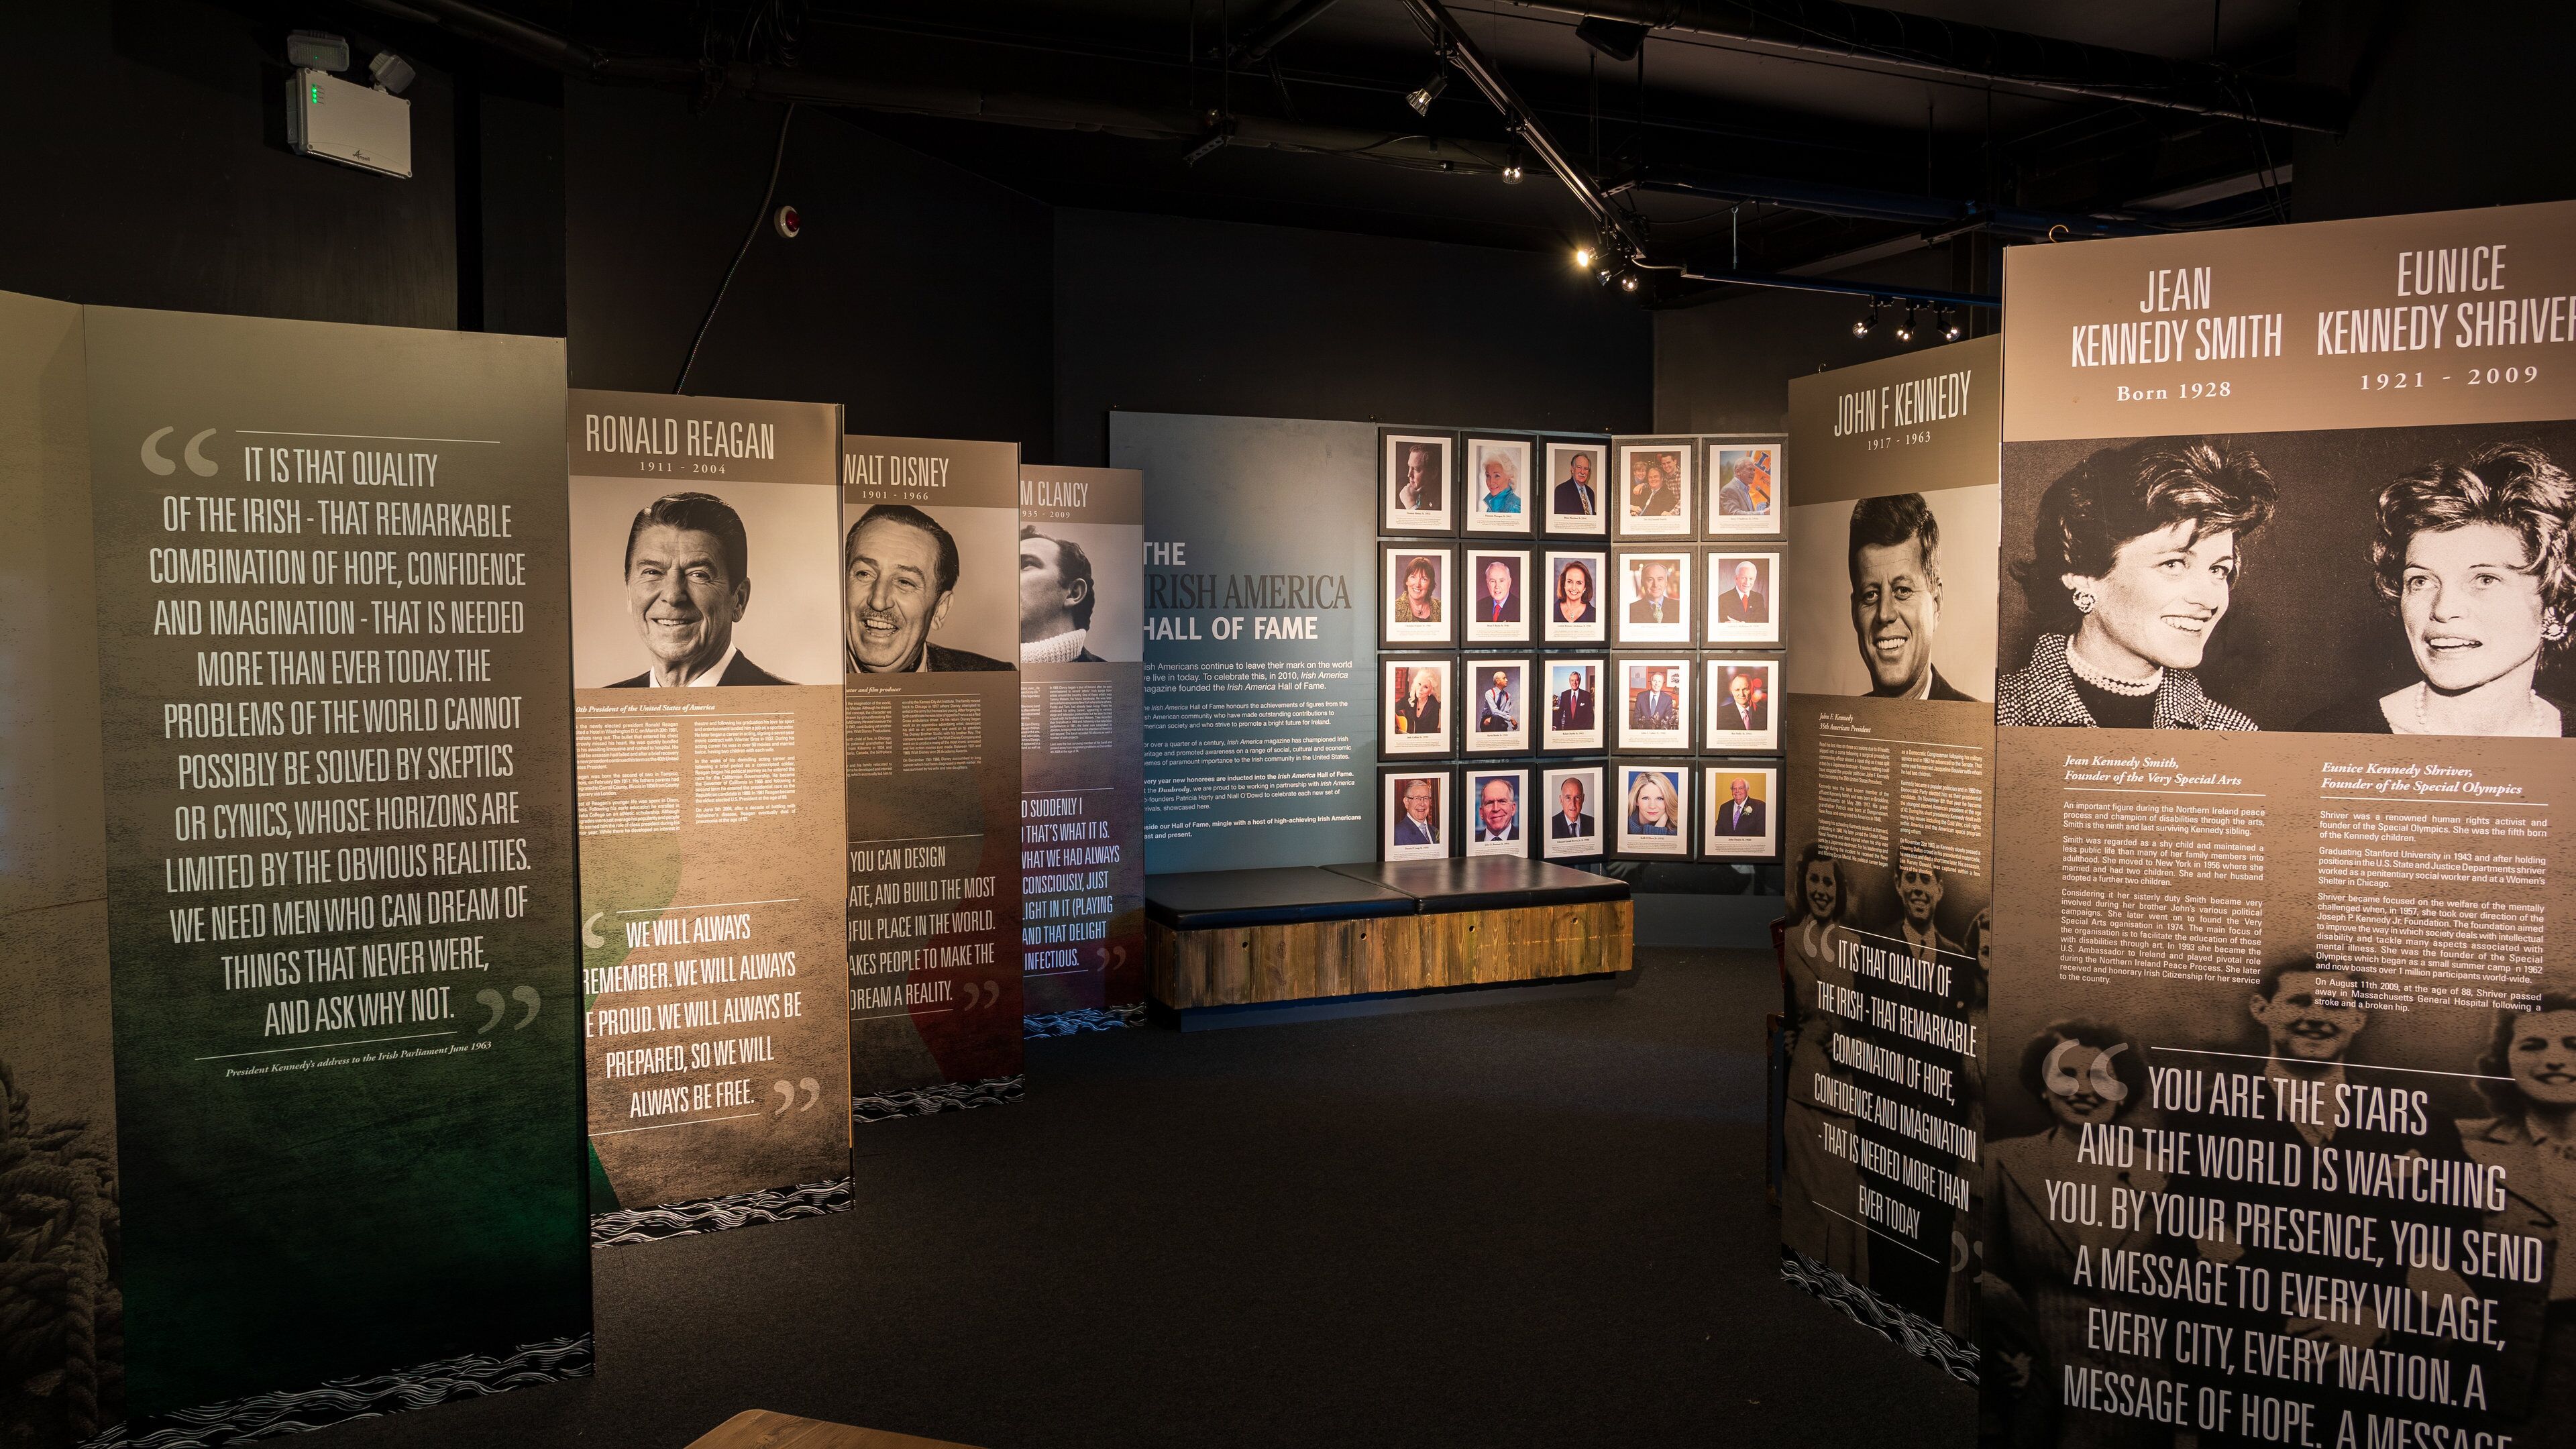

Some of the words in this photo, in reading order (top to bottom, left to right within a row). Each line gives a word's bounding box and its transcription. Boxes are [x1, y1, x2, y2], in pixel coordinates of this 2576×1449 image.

[2398, 245, 2506, 297] EUNICE
[2140, 267, 2210, 313] JEAN
[2072, 319, 2188, 367] KENNEDY
[2196, 313, 2282, 360] SMITH
[2318, 305, 2448, 356] KENNEDY
[2361, 372, 2423, 390] 1921
[2467, 366, 2537, 384] 2009
[1835, 389, 1875, 437] JOHN
[1882, 386, 1889, 429] F
[1895, 370, 1971, 427] KENNEDY
[2116, 386, 2167, 401] Born
[2180, 382, 2230, 398] 1928
[586, 415, 678, 455] RONALD
[688, 420, 773, 460] REAGAN
[1868, 437, 1891, 450] 1917
[1907, 431, 1930, 445] 1963
[245, 447, 263, 482] IT
[270, 448, 289, 482] IS
[293, 449, 345, 484] THAT
[353, 451, 437, 487] QUALITY
[641, 462, 672, 472] 1911
[693, 464, 724, 474] 2004
[843, 454, 884, 485] WALT
[891, 456, 949, 487] DISNEY
[1038, 481, 1088, 507] CLANCY
[164, 496, 191, 531] OF
[196, 497, 237, 532] THE
[244, 498, 301, 533] IRISH
[317, 500, 370, 535] THAT
[376, 502, 511, 537] REMARKABLE
[1144, 542, 1186, 566] THE
[1144, 574, 1217, 609] RISH
[1224, 574, 1352, 609] AMERICA
[1144, 616, 1202, 641] HALL
[1212, 616, 1244, 641] OF
[1254, 616, 1318, 640] FAME
[620, 705, 628, 714] of
[682, 704, 690, 712] of
[1819, 712, 1829, 720] John
[1835, 714, 1854, 723] Kennedy
[1829, 723, 1850, 731] American
[1850, 724, 1872, 733] President
[2063, 755, 2089, 767] Jean
[2091, 756, 2140, 769] Kennedy
[2143, 757, 2179, 769] Smith,
[2321, 762, 2363, 773] Eunice
[2365, 763, 2421, 777] Kennedy
[2424, 765, 2472, 777] Shriver,
[2064, 770, 2111, 781] Founder
[2113, 771, 2127, 784] of
[2127, 771, 2144, 782] the
[2148, 773, 2171, 786] Very
[2174, 773, 2216, 786] Special
[2216, 775, 2242, 785] Arts
[2320, 778, 2373, 789] Founder
[2375, 780, 2392, 793] of
[2392, 780, 2410, 790] the
[2413, 781, 2460, 794] Special
[2463, 782, 2522, 796] Olympics
[1030, 798, 1077, 817] SUDDENLY
[1079, 798, 1081, 814] I
[2112, 803, 2133, 812] figure
[2136, 804, 2159, 814] during
[2176, 806, 2209, 814] Northern
[2212, 807, 2239, 815] Ireland
[2320, 810, 2349, 819] Shriver
[2432, 815, 2461, 823] human
[2466, 816, 2489, 826] rights
[2495, 818, 2526, 826] activist
[1060, 822, 1086, 841] WHAT
[1089, 822, 1097, 839] IT
[1099, 821, 1110, 839] IS.
[850, 851, 873, 872] YOU
[878, 849, 900, 871] CAN
[905, 846, 945, 869] DESIGN
[626, 921, 650, 948] WE
[653, 918, 690, 946] WILL
[693, 914, 750, 943] ALWAYS
[1025, 949, 1079, 970] INFECTIOUS.
[1839, 939, 1847, 969] IT
[1850, 943, 1859, 972] IS
[1861, 945, 1886, 979] THAT
[1889, 953, 1935, 993] QUALITY
[1937, 965, 1951, 997] OF
[2082, 976, 2110, 984] country.
[850, 986, 891, 1010] DREAM
[894, 985, 902, 1006] A
[906, 980, 953, 1005] REALITY.
[265, 1000, 309, 1036] AND
[315, 995, 356, 1031] ASK
[358, 990, 405, 1026] WHY
[411, 986, 455, 1022] NOT.
[226, 1066, 269, 1077] President
[317, 1057, 350, 1067] address
[363, 1054, 376, 1062] the
[378, 1051, 398, 1060] Irish
[400, 1047, 447, 1058] Parliament
[448, 1045, 468, 1055] June
[471, 1041, 491, 1050] 1963
[630, 1086, 689, 1118] ALWAYS
[694, 1083, 712, 1110] BE
[716, 1079, 755, 1108] FREE.
[2149, 1066, 2202, 1112] YOU
[2209, 1073, 2265, 1119] ARE
[2273, 1077, 2325, 1125] THE
[2334, 1083, 2427, 1135] STARS
[2078, 1122, 2133, 1168] AND
[2142, 1128, 2191, 1175] THE
[2198, 1134, 2301, 1187] WORLD
[2313, 1146, 2338, 1191] IS
[2345, 1150, 2506, 1211] WATCHING
[1860, 1185, 1882, 1223] EVER
[1885, 1197, 1920, 1239] TODAY
